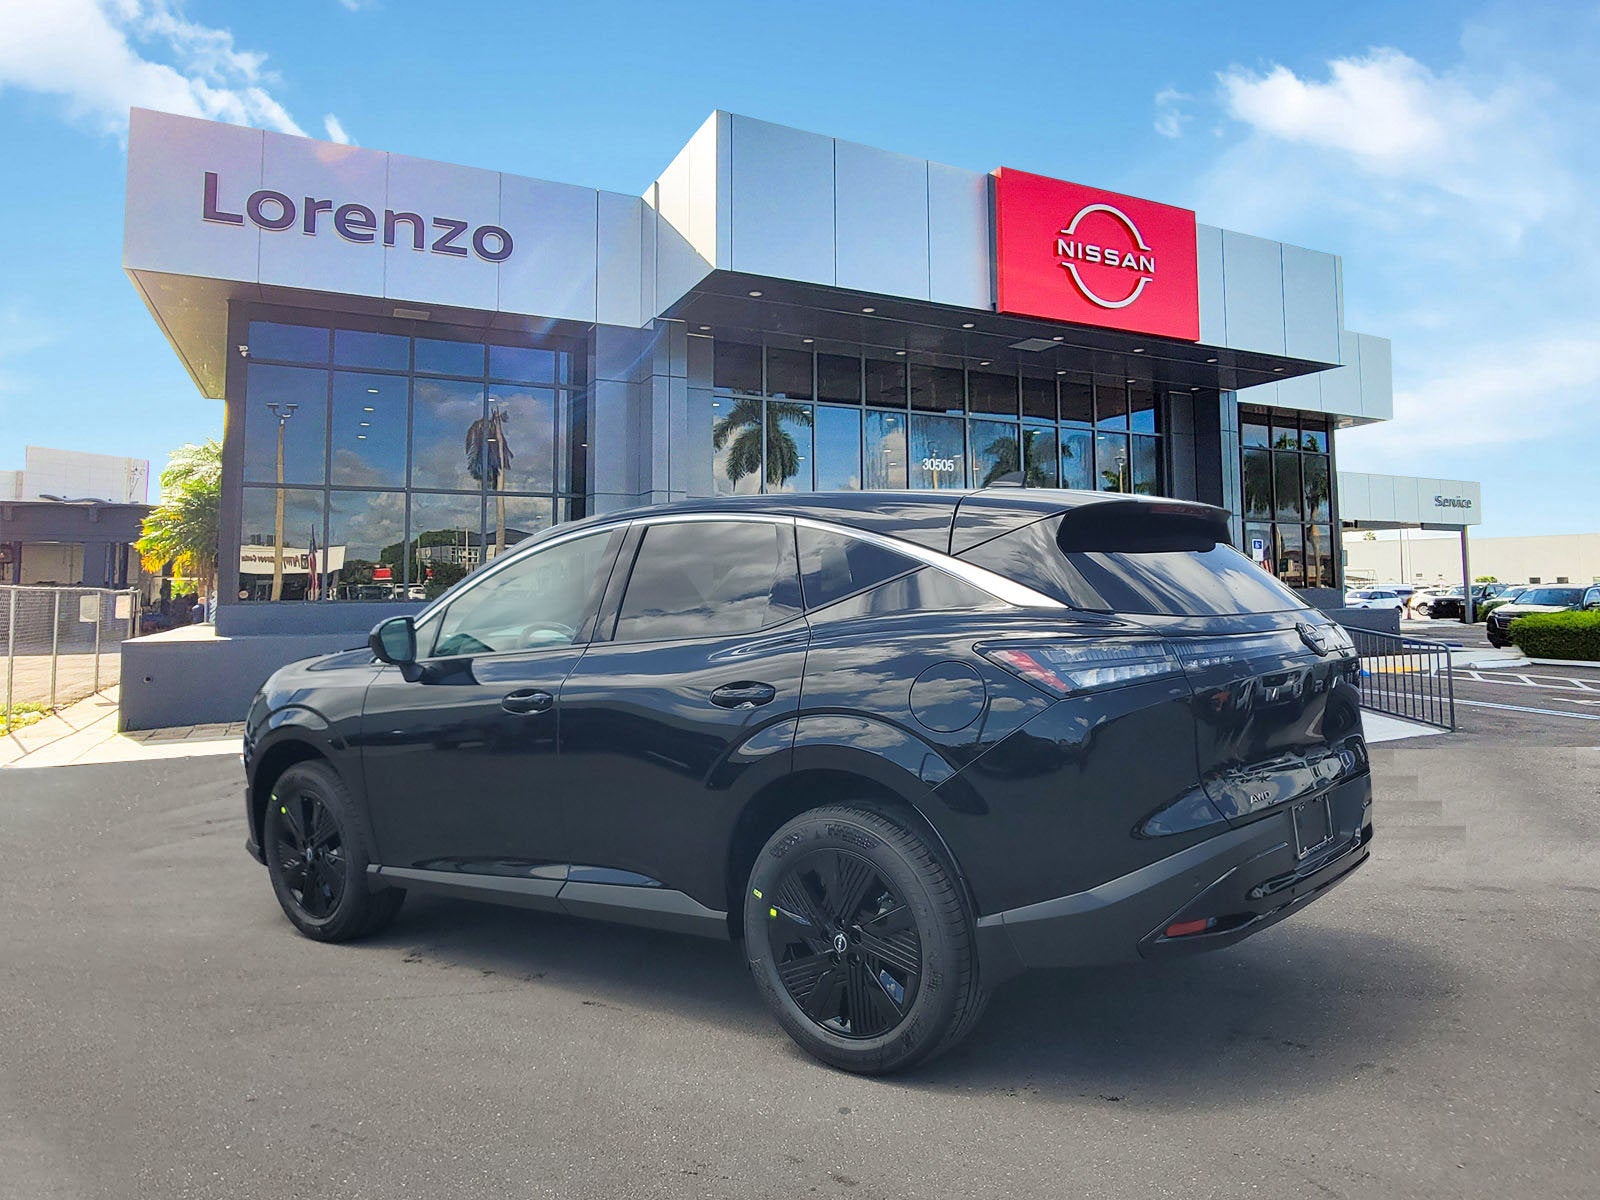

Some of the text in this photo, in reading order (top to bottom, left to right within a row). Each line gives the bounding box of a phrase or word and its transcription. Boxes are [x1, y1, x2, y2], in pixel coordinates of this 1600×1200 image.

[202, 170, 515, 263] Lorenzo
[1057, 238, 1155, 273] NISSAN
[922, 457, 955, 472] 30505
[1434, 495, 1472, 509] Service
[1250, 790, 1271, 804] AWD
